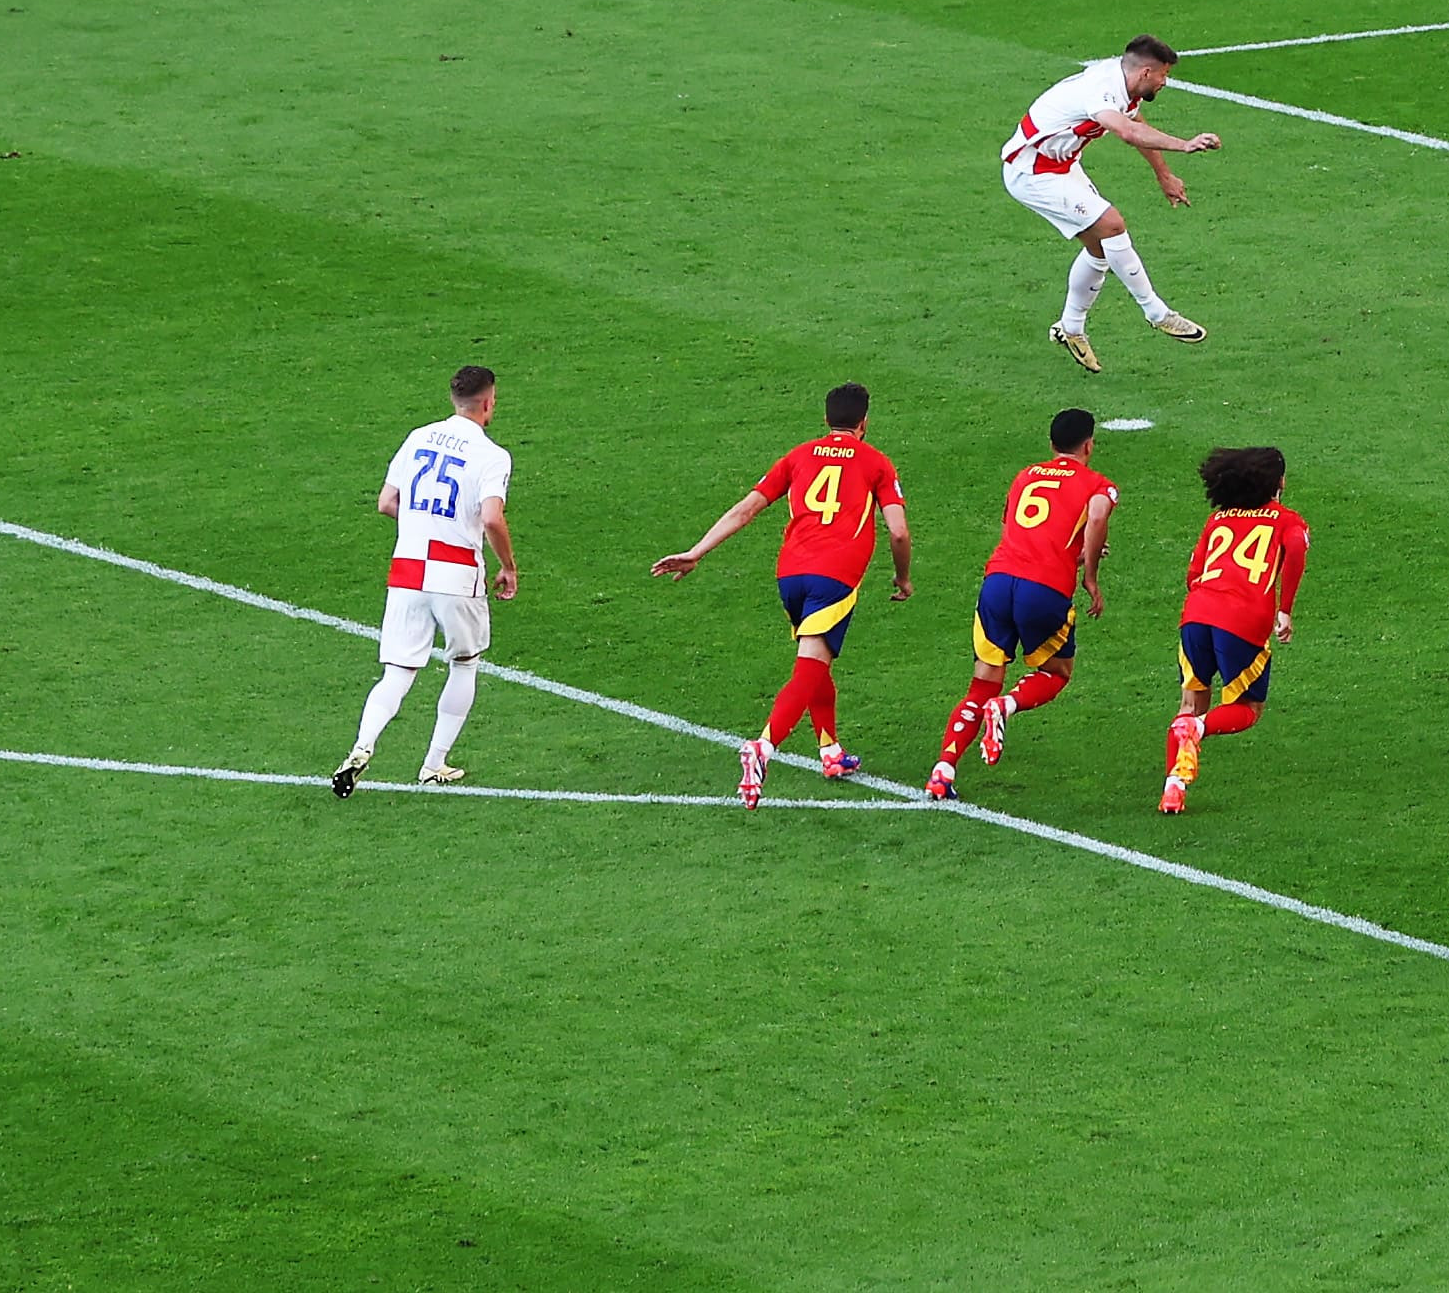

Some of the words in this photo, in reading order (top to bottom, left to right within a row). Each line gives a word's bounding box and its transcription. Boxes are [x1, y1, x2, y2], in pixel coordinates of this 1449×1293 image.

[811, 445, 855, 459] NACHO
[1027, 465, 1076, 477] MERINO
[408, 448, 466, 521] 25
[803, 464, 842, 525] 4
[1014, 480, 1061, 529] 6
[1213, 506, 1279, 521] CUCURELLA
[1193, 524, 1274, 586] 24
